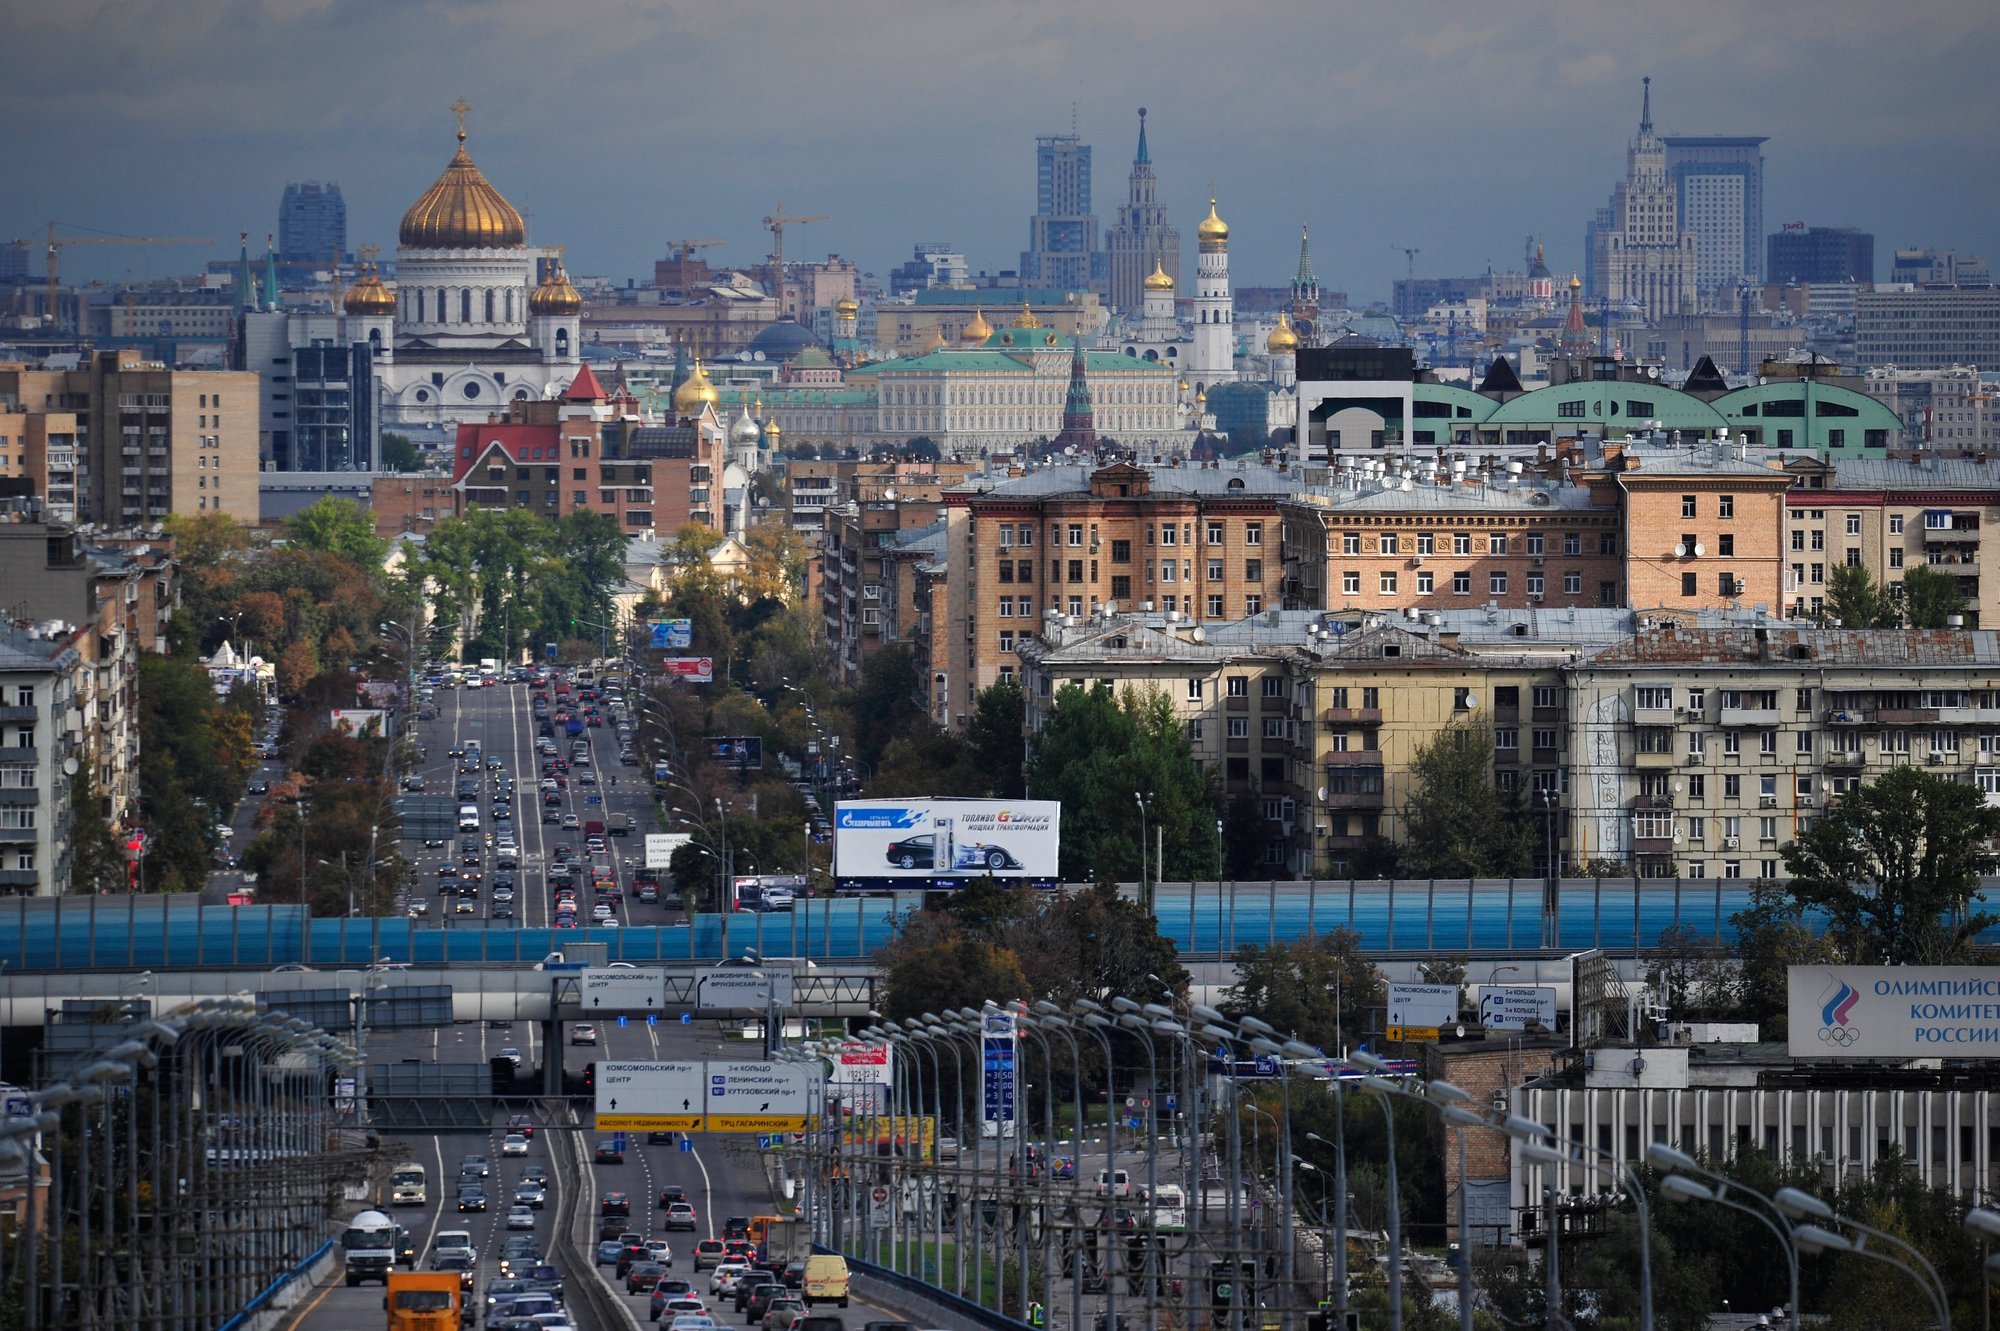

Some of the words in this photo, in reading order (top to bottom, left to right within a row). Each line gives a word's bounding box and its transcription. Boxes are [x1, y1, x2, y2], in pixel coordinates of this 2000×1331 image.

[961, 814, 996, 822] ТОПЛИВО
[1393, 986, 1441, 994] КОМСОМОЛЬСКИЙ
[1874, 978, 2000, 996] ОЛИМПИЙС
[1911, 1004, 2000, 1019] КОМИТЕТ
[1915, 1027, 1999, 1043] РОССИИ
[606, 1064, 675, 1072] КОМСОМОЛЬСКИЙ
[992, 1111, 1007, 1119] АС
[599, 1119, 632, 1127] АБСОЛЮТ
[633, 1119, 689, 1127] НЕДВИЖИМОСТЬ
[720, 1120, 734, 1128] ТРЦ
[735, 1119, 789, 1127] ГАГАРИНСКИЙ
